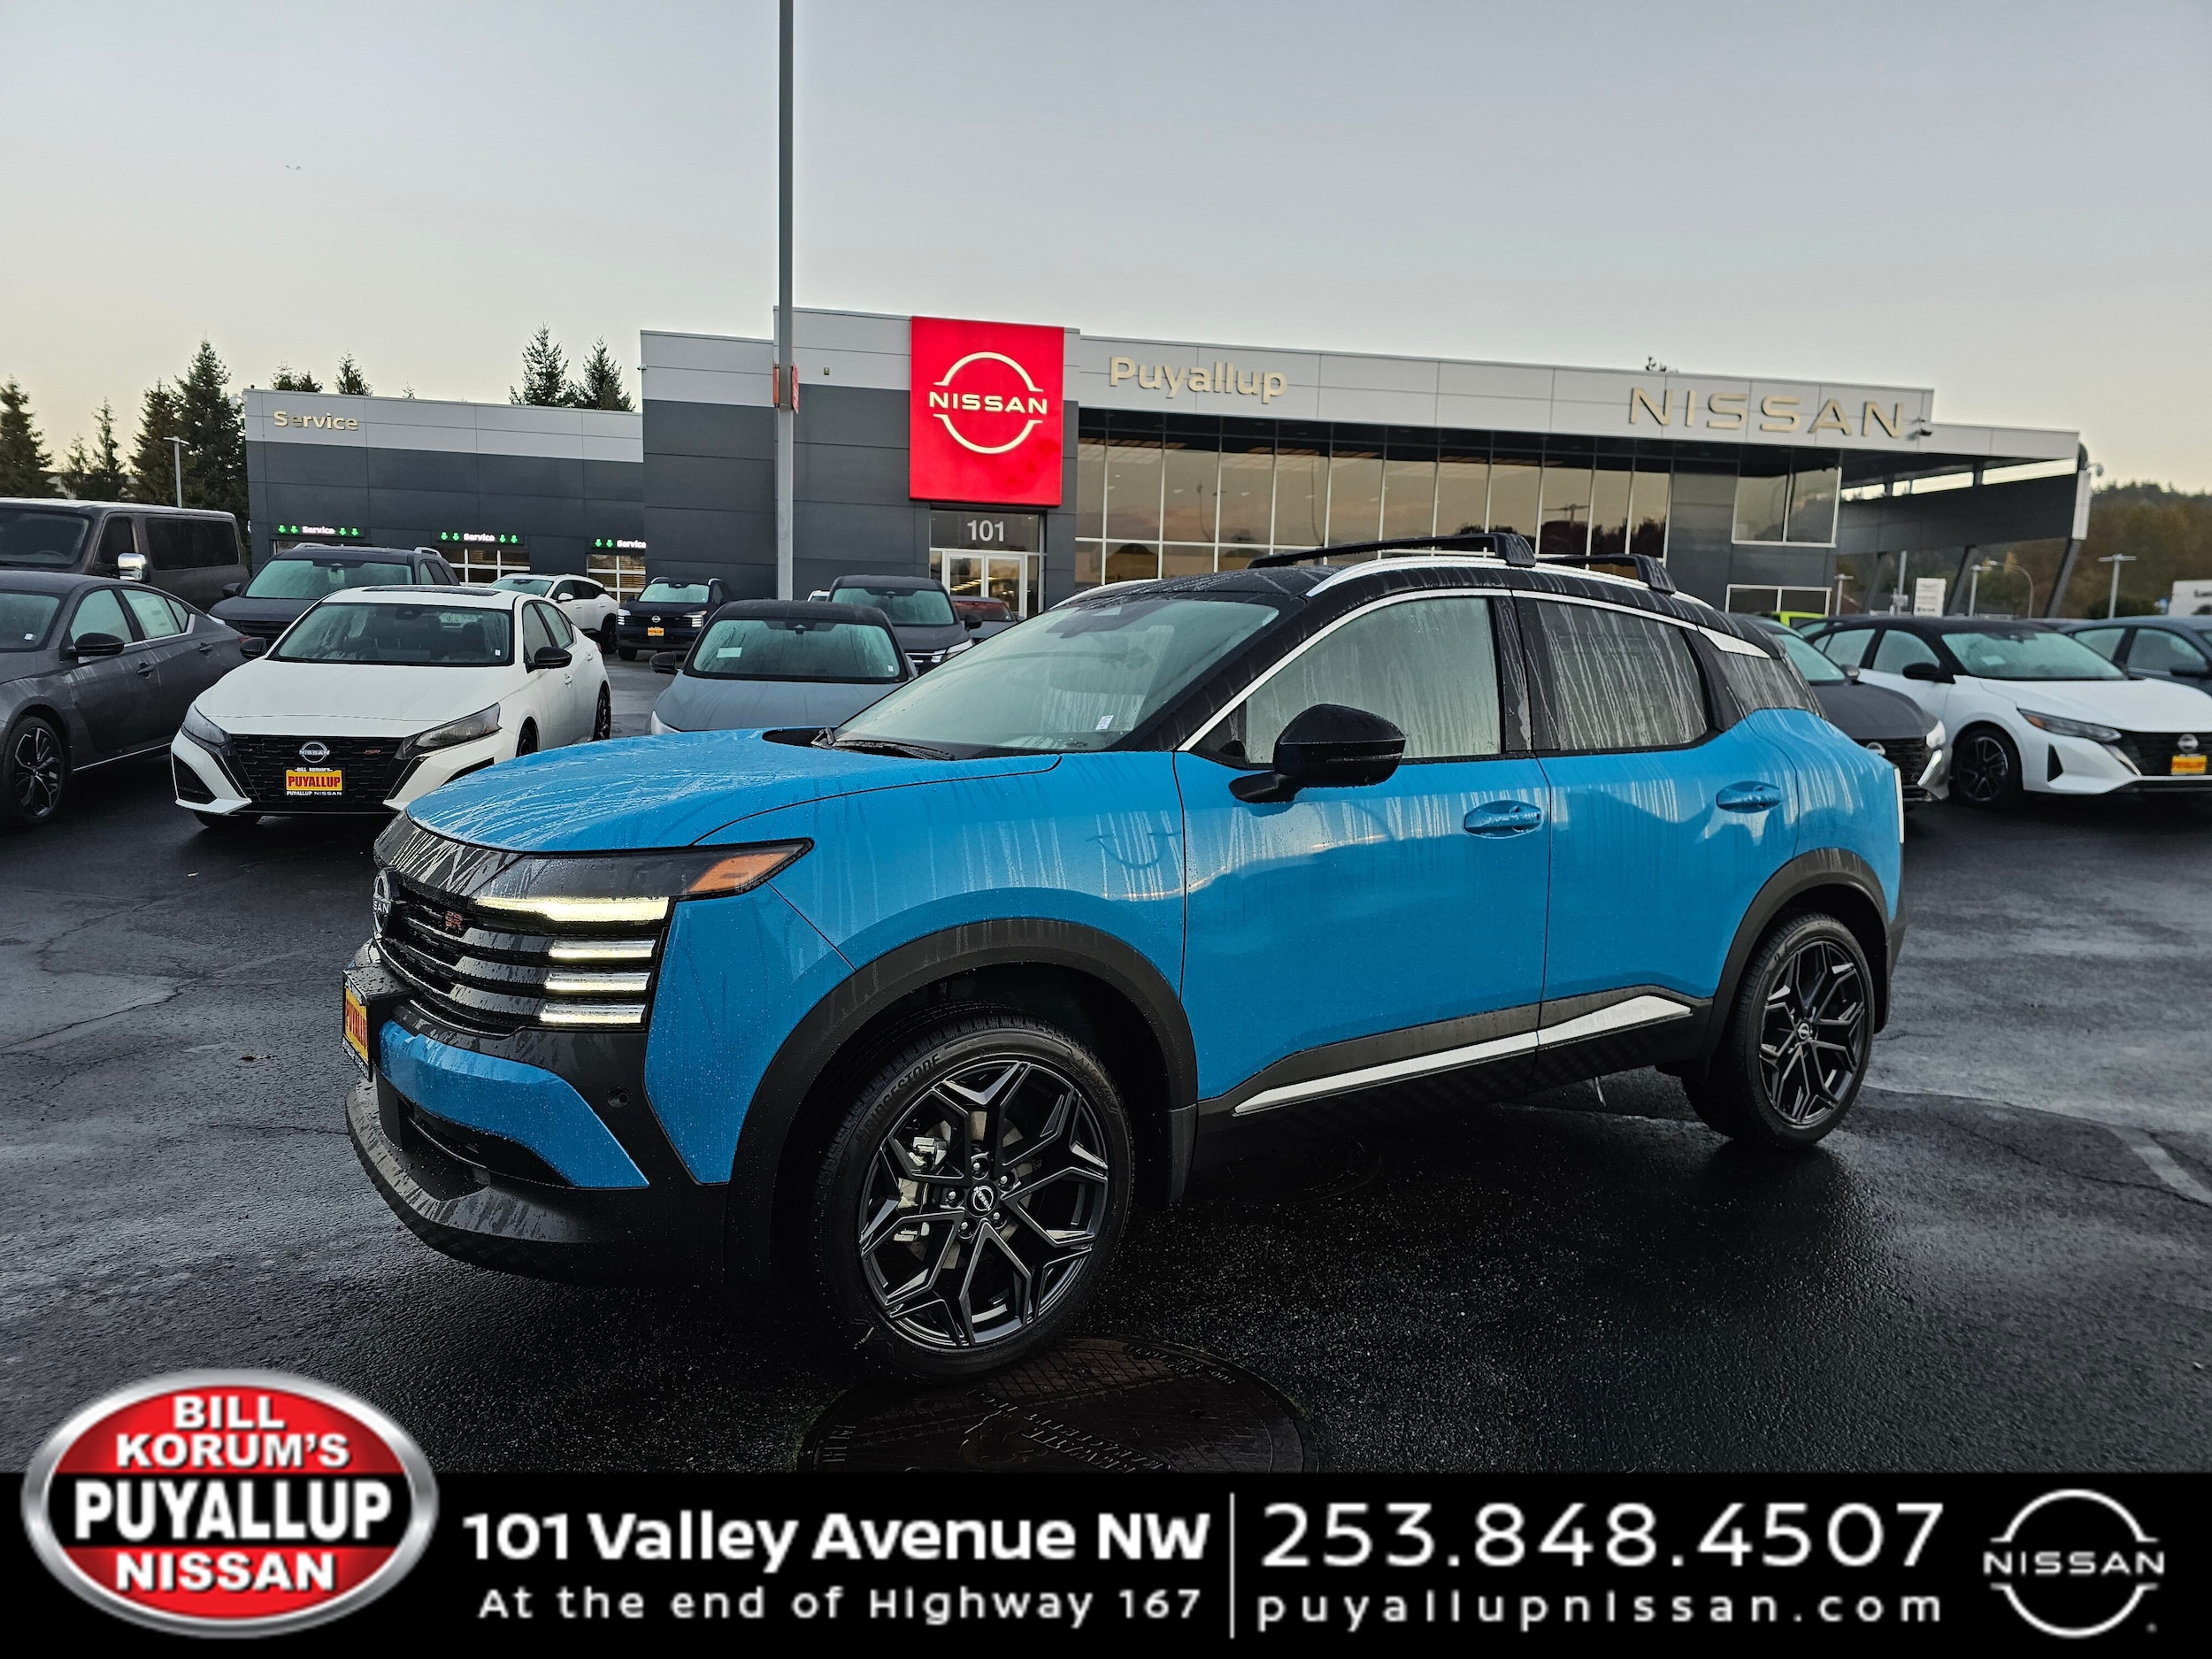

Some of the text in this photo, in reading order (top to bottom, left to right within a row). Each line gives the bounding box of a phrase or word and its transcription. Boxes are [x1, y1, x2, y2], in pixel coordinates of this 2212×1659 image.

[1110, 357, 1288, 403] Puyallup
[929, 391, 1048, 415] NISSAN
[1629, 387, 1904, 438] NISSAN
[273, 411, 358, 430] Service
[302, 526, 336, 534] Service
[463, 533, 495, 541] Service
[967, 519, 1004, 541] 101
[617, 539, 647, 549] Service
[288, 776, 341, 787] PUYALLUP
